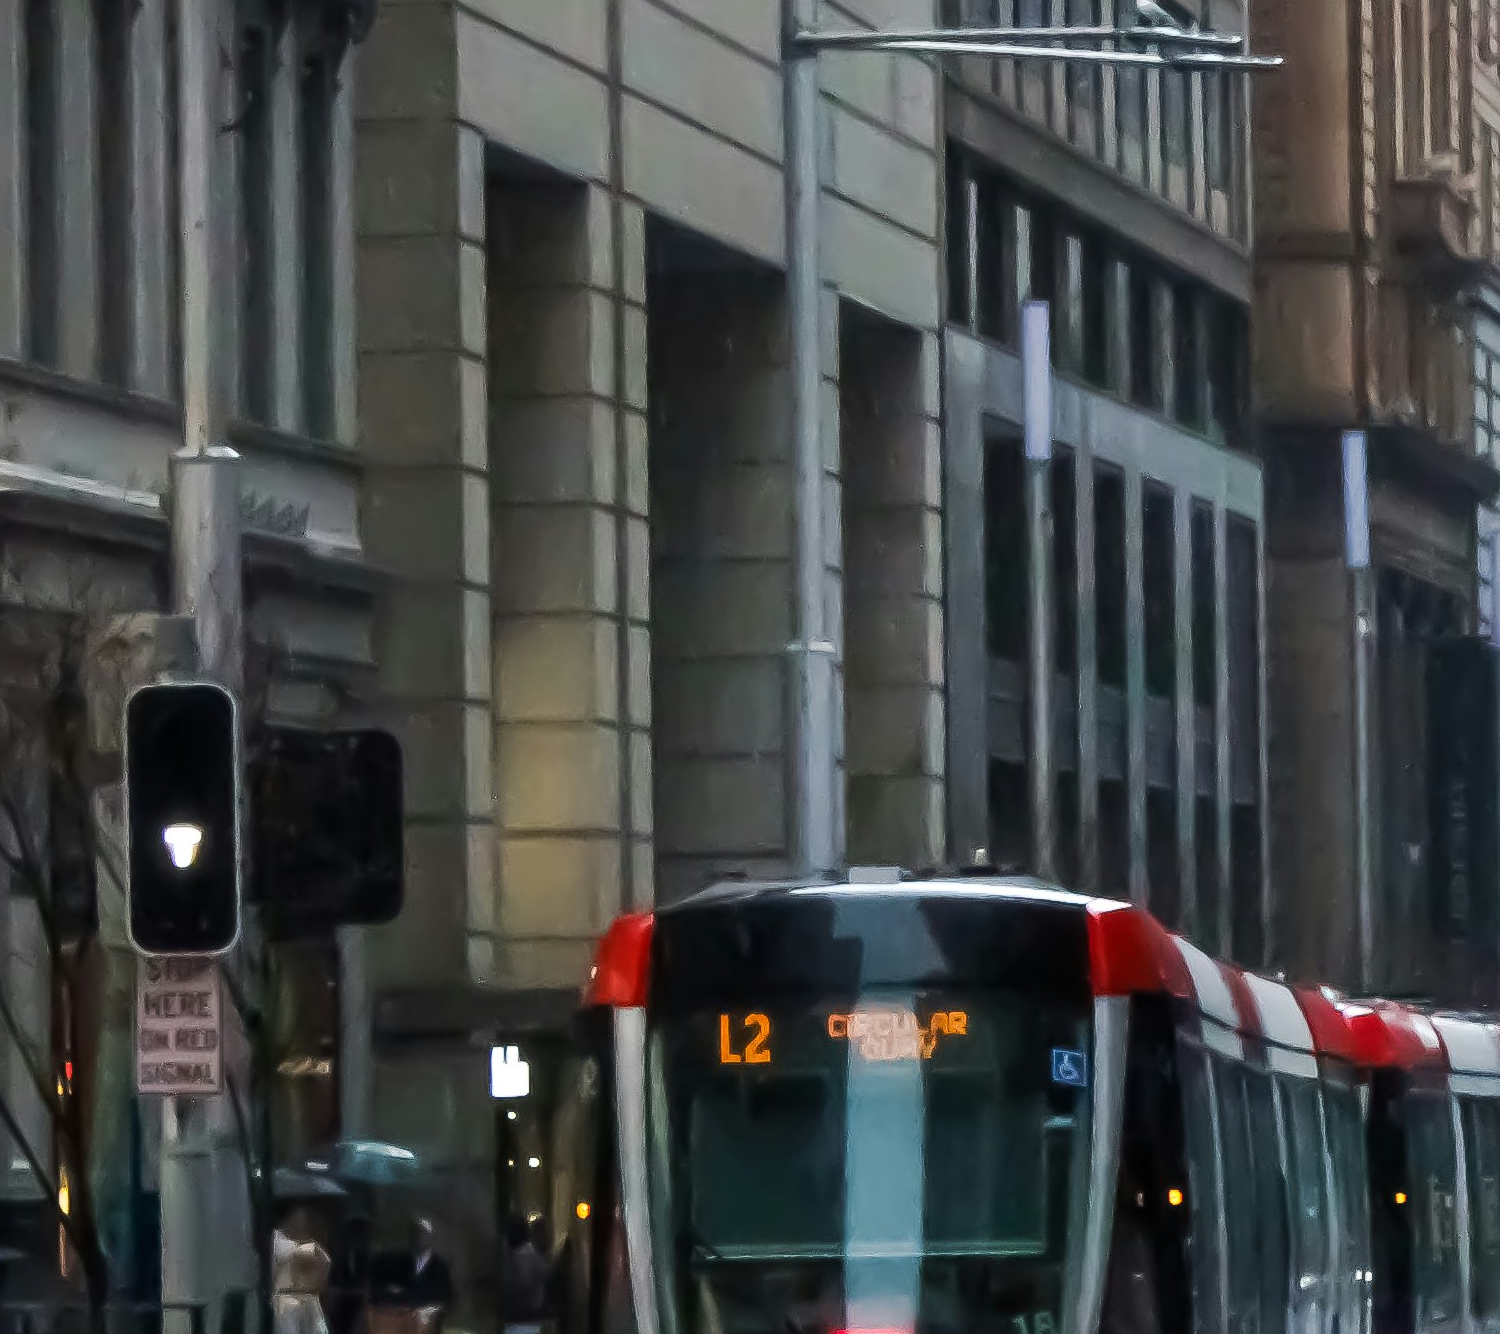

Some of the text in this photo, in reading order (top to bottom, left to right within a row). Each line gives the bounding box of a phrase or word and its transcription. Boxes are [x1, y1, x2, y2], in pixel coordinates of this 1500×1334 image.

[143, 991, 213, 1018] HERE
[719, 1012, 772, 1064] L2
[140, 1060, 215, 1085] SIGNAL
